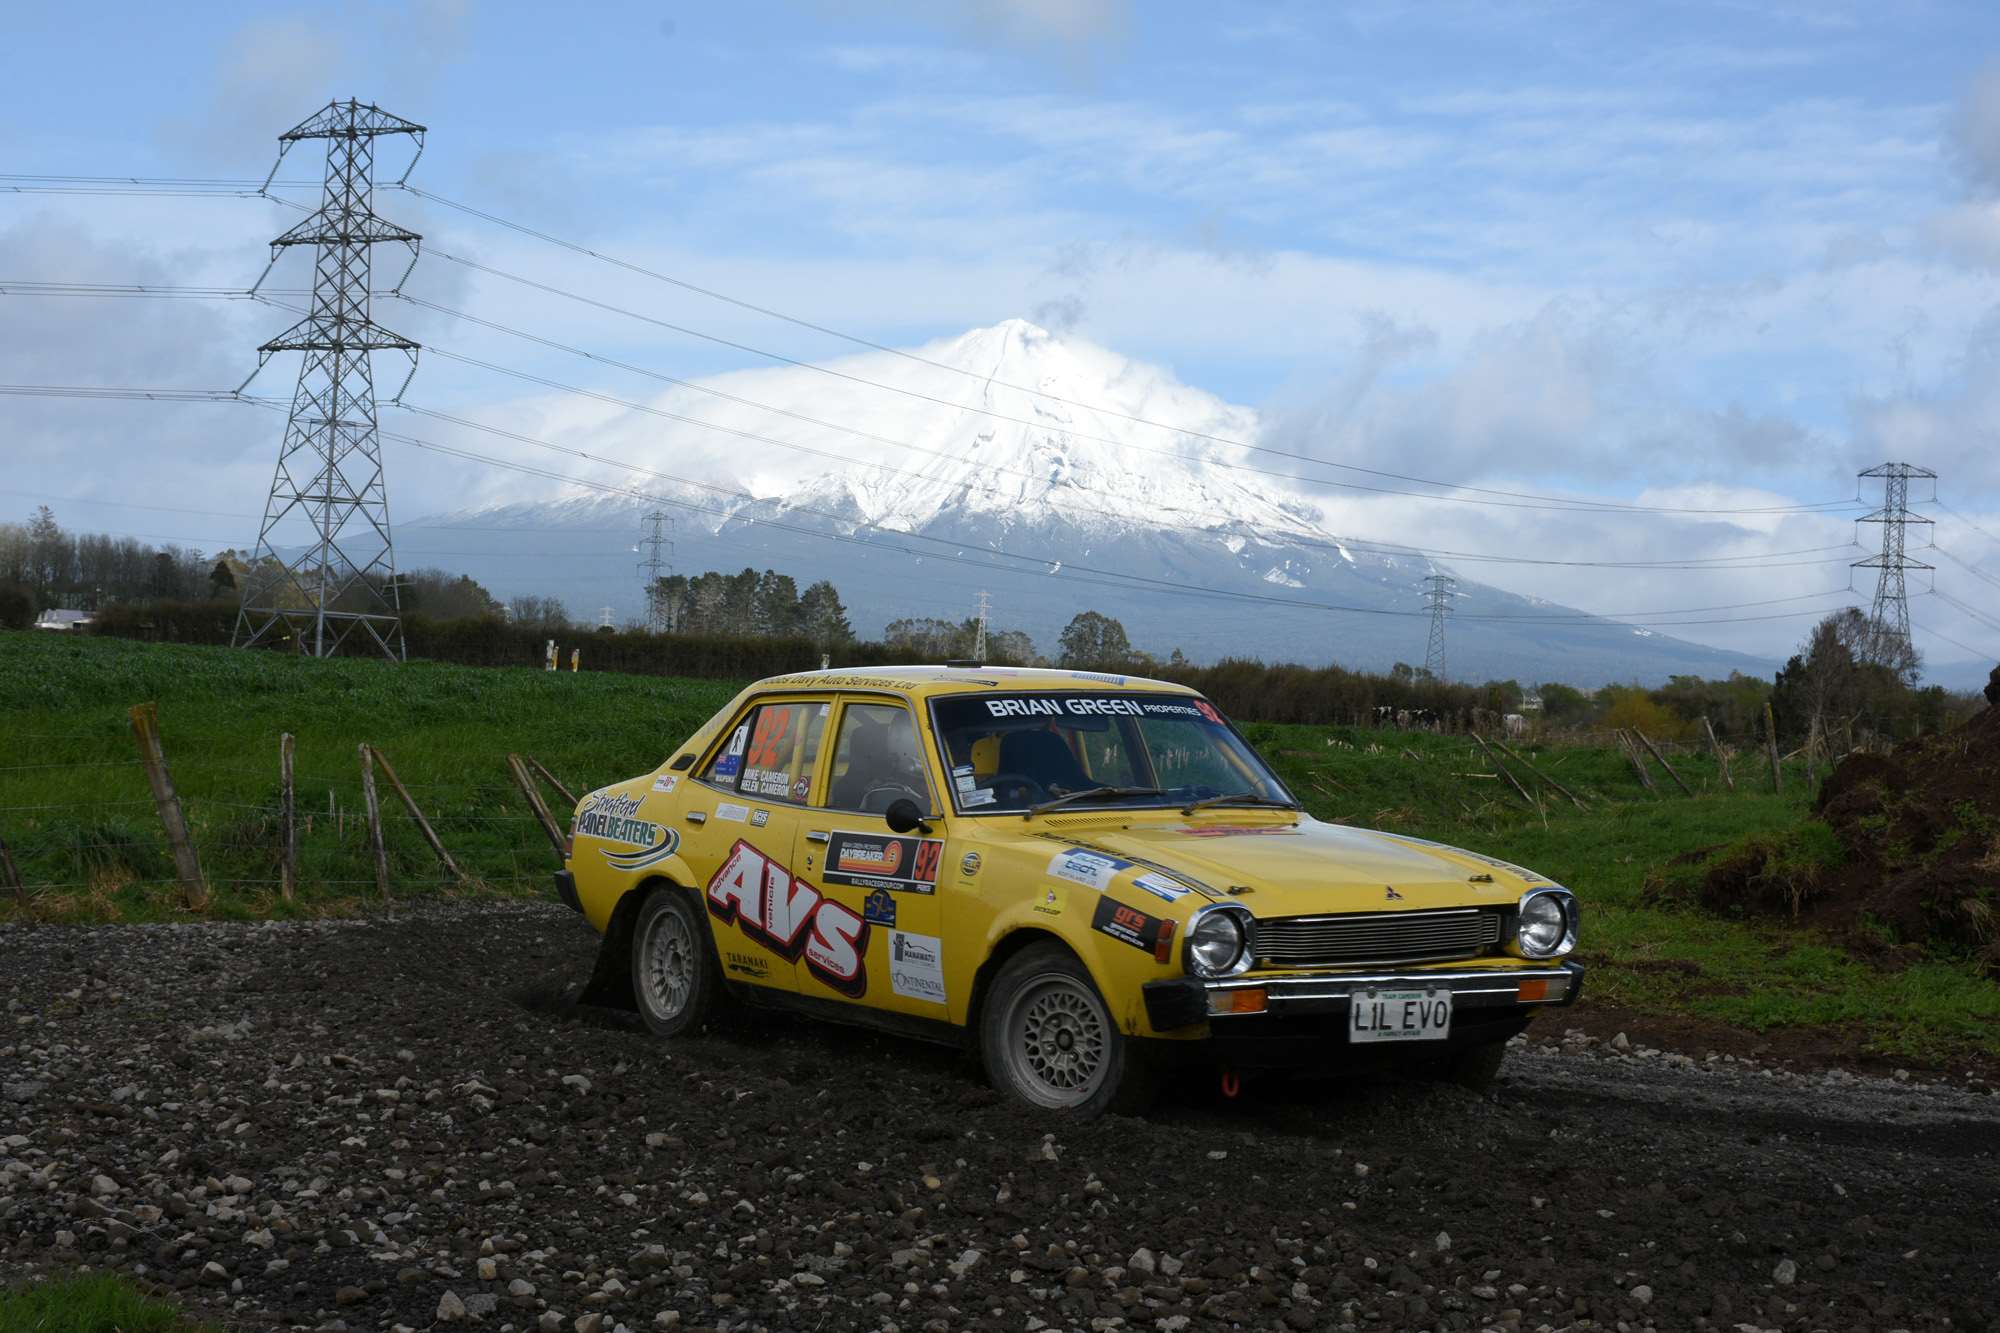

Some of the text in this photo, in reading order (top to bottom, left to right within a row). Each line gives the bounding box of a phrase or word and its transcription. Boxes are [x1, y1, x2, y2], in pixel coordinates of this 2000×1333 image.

[846, 677, 895, 688] Services
[985, 699, 1201, 717] BRIAN GREEN PROPERTIES
[748, 707, 790, 768] 92
[740, 780, 760, 793] HELEN
[760, 782, 790, 797] CAMERON
[743, 768, 790, 785] MIKE CAMERON
[581, 793, 646, 817] Stratford
[840, 848, 884, 862] DAYBREAKER
[914, 841, 941, 881] 92
[713, 854, 742, 894] advance
[709, 844, 863, 978] AVS
[1113, 906, 1146, 931] grs
[726, 952, 768, 969] TARANAKI
[809, 948, 845, 974] services
[1402, 1000, 1448, 1030] EVO
